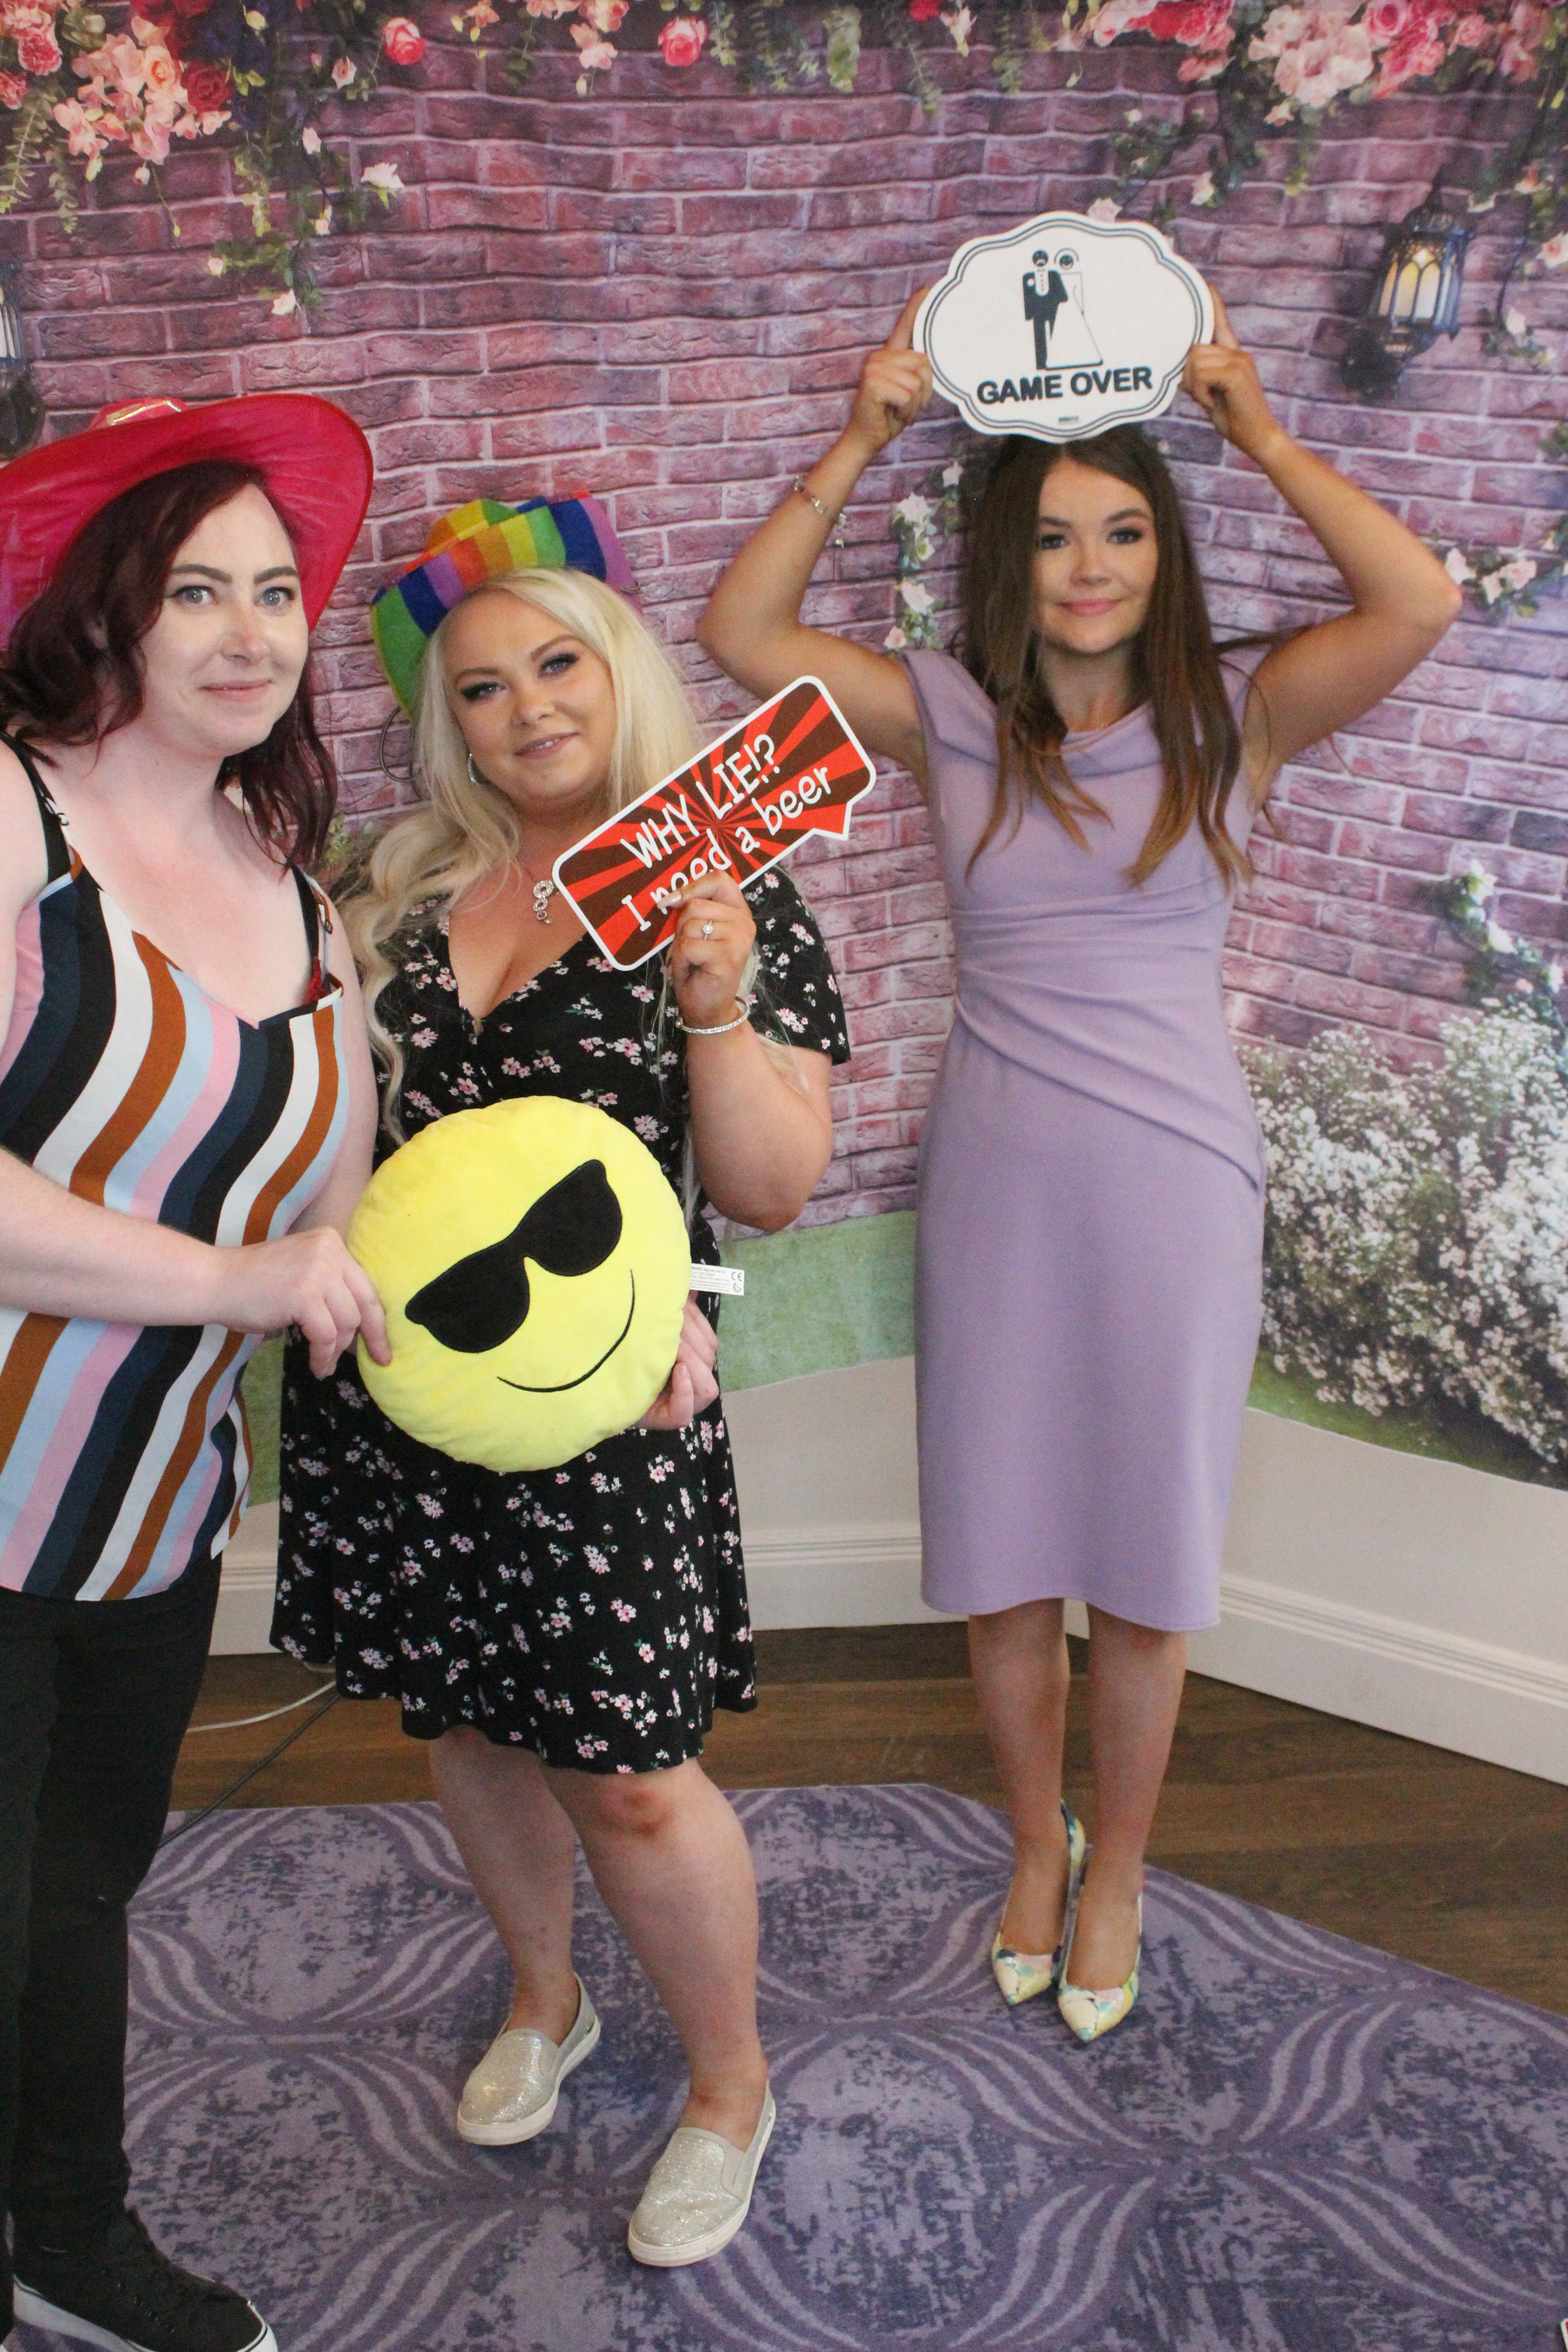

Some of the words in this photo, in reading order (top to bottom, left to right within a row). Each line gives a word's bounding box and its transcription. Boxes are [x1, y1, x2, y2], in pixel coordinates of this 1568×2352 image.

[977, 375, 1063, 405] GAME
[1070, 367, 1152, 396] OVER
[620, 794, 700, 868] WHY
[695, 734, 780, 820] LIE!?
[621, 894, 652, 931] I
[735, 826, 760, 854] a
[751, 766, 832, 836] beer
